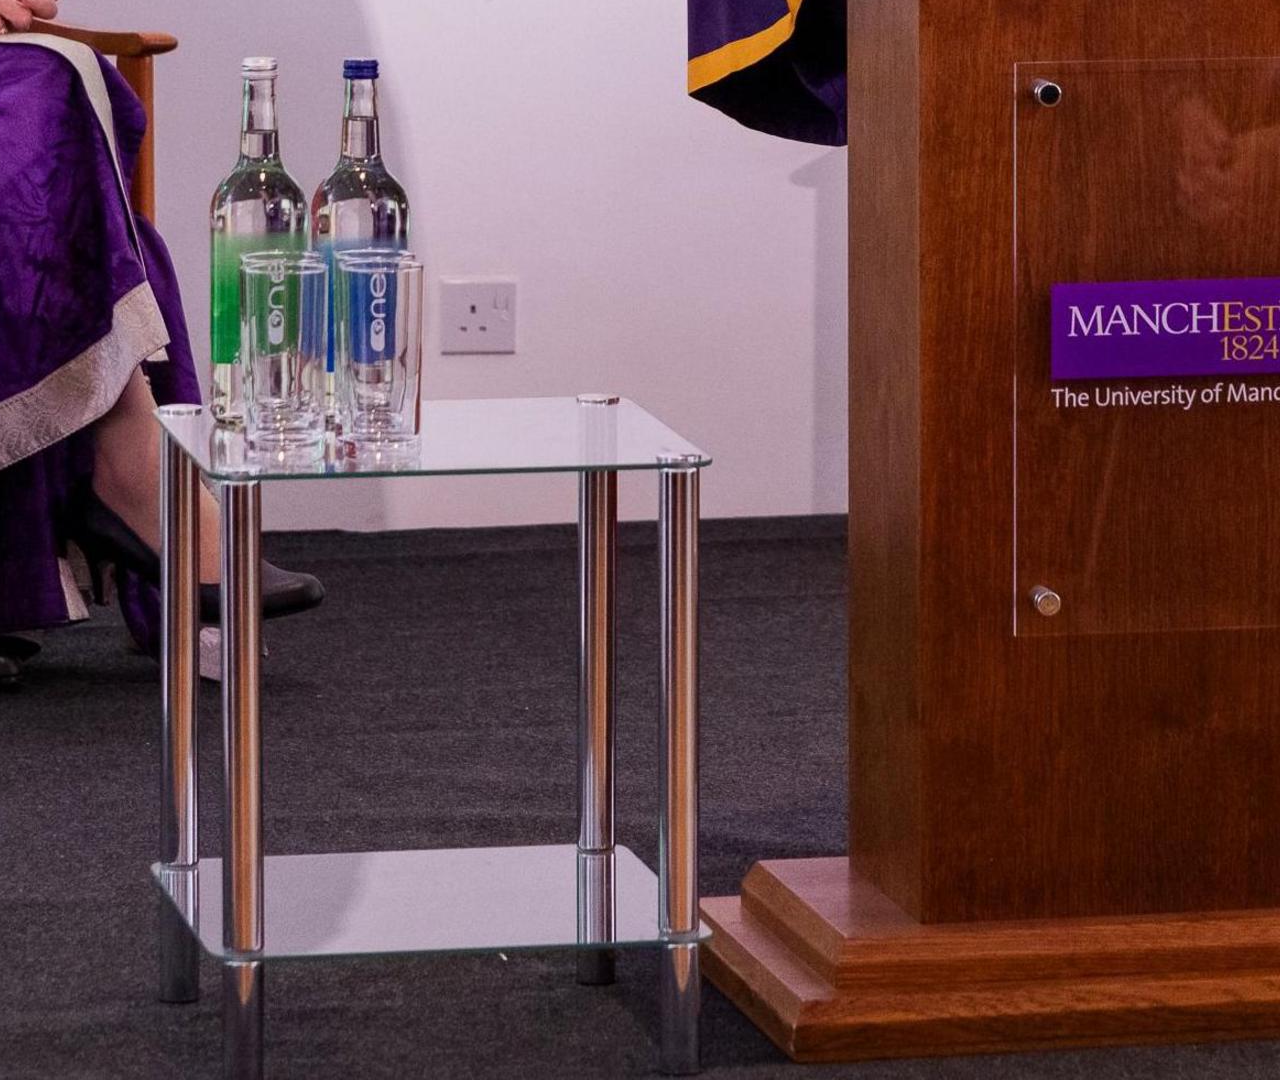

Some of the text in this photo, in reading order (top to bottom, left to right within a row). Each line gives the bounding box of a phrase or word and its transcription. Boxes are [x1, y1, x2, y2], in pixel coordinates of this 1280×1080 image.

[370, 272, 387, 352] one
[1220, 334, 1280, 361] 1824
[1051, 387, 1090, 408] The
[1095, 384, 1196, 411] University
[1200, 382, 1224, 404] of
